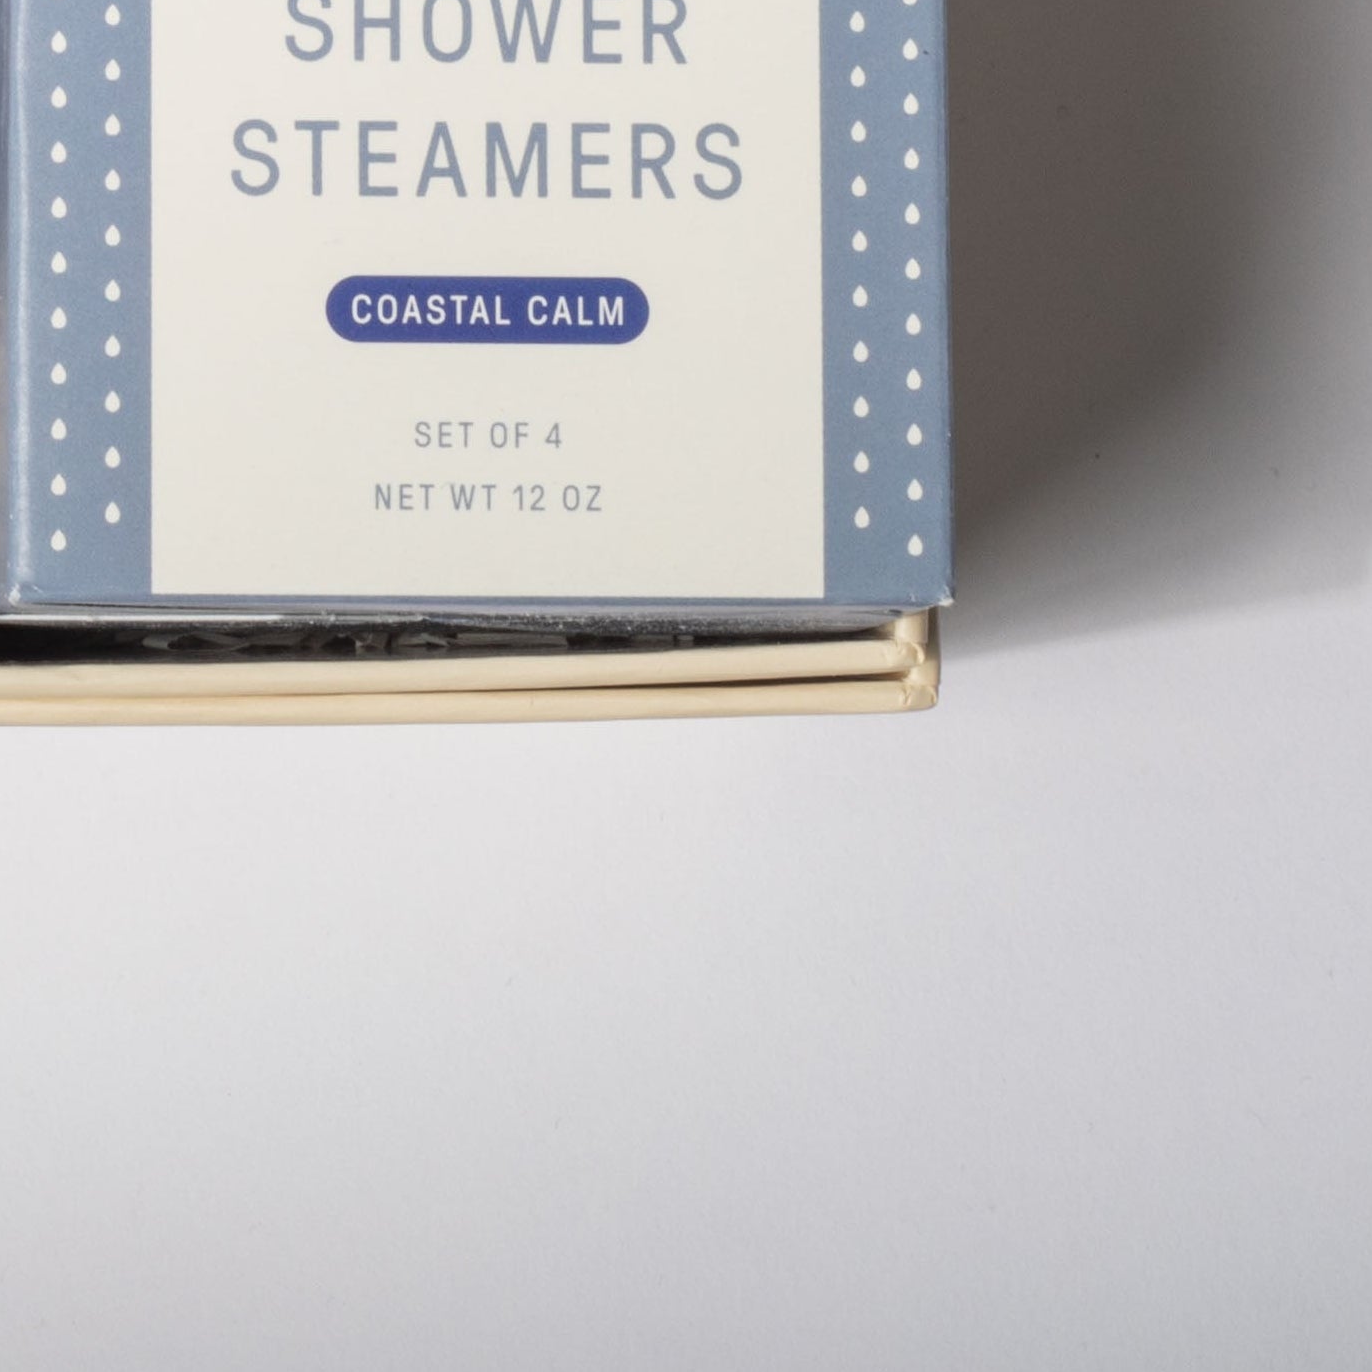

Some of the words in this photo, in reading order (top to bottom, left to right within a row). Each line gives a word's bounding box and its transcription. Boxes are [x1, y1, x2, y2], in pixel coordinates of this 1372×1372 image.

[231, 119, 743, 201] STEAMERS
[351, 294, 512, 326] COASTAL
[527, 295, 626, 327] CALM
[414, 422, 473, 448] SET
[489, 422, 531, 448] OF
[545, 422, 563, 448] 4
[375, 484, 433, 511] NET
[451, 484, 496, 512] WT
[512, 484, 546, 512] 12
[565, 485, 603, 513] OZ
